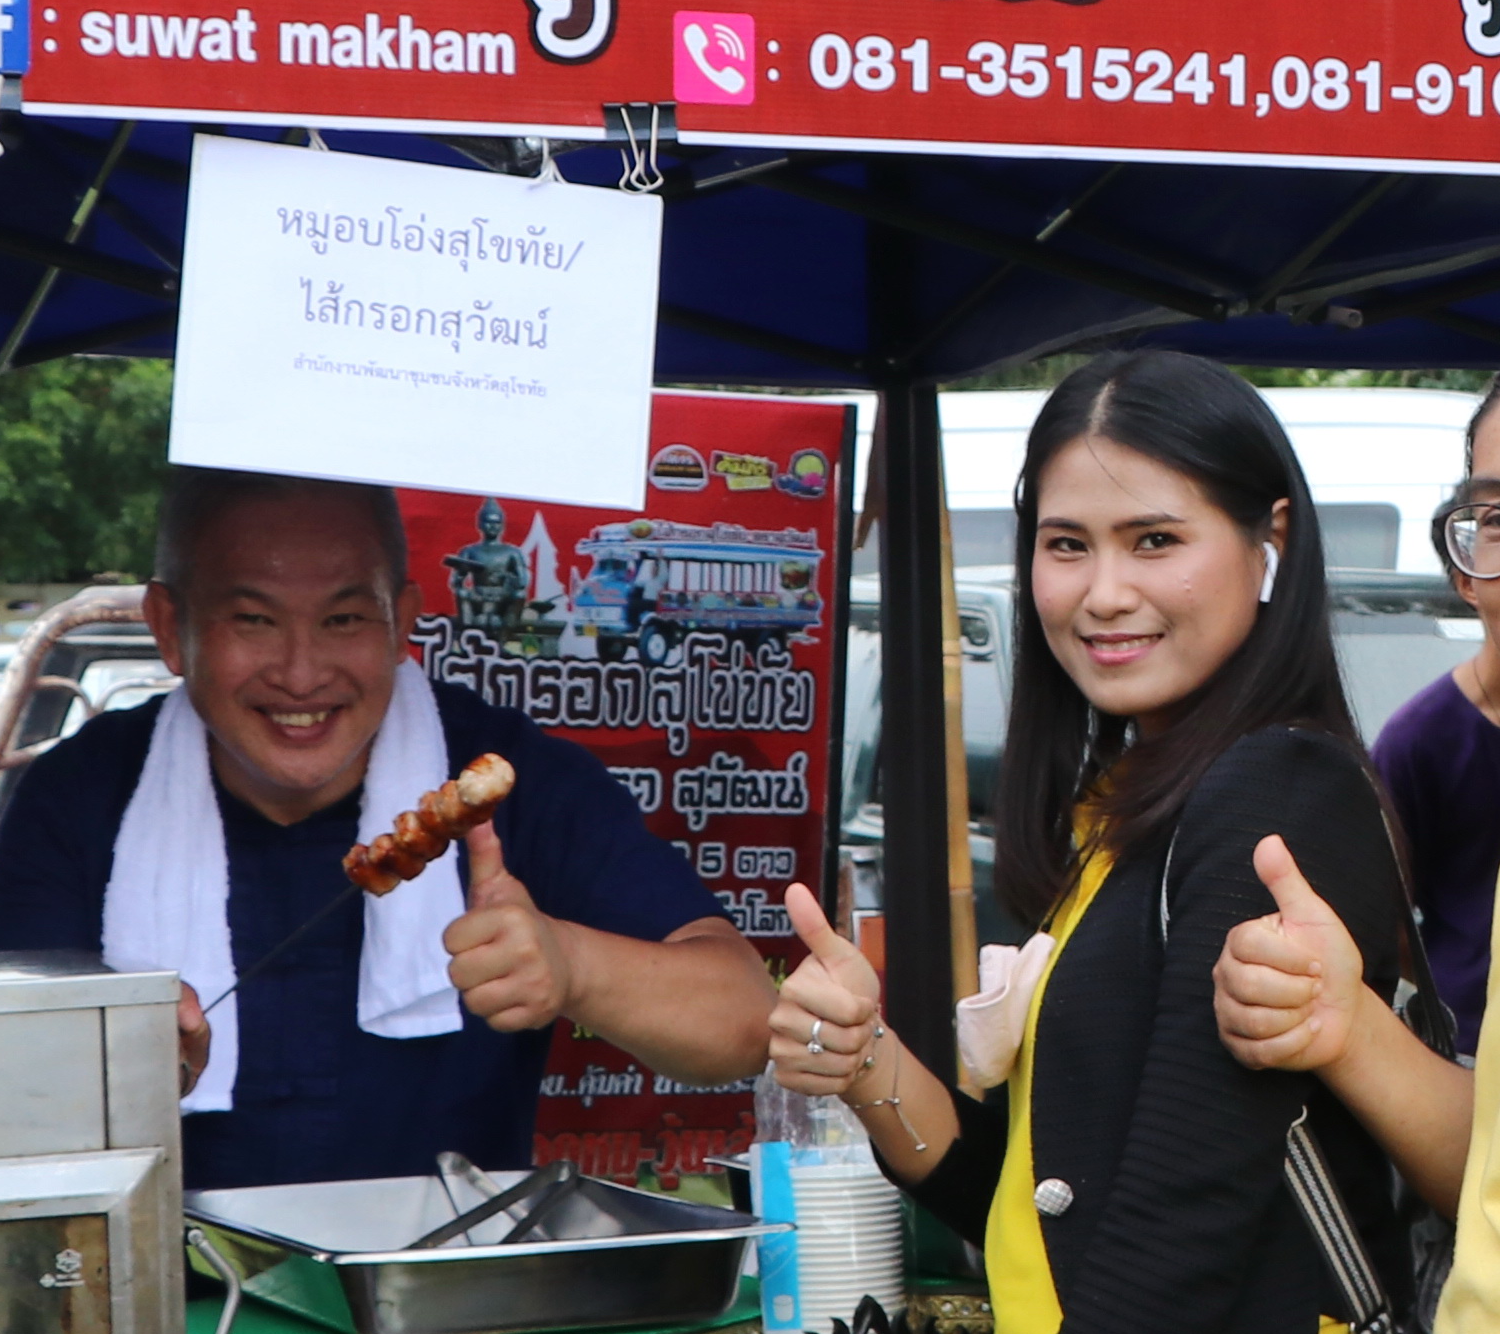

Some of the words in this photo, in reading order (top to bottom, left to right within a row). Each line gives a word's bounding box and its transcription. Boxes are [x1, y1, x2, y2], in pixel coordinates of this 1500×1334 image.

[80, 2, 258, 65] suwat
[278, 14, 517, 78] makham
[299, 275, 551, 354] ไส้กรอกสุวัฒน์
[732, 844, 797, 880] ดาว
